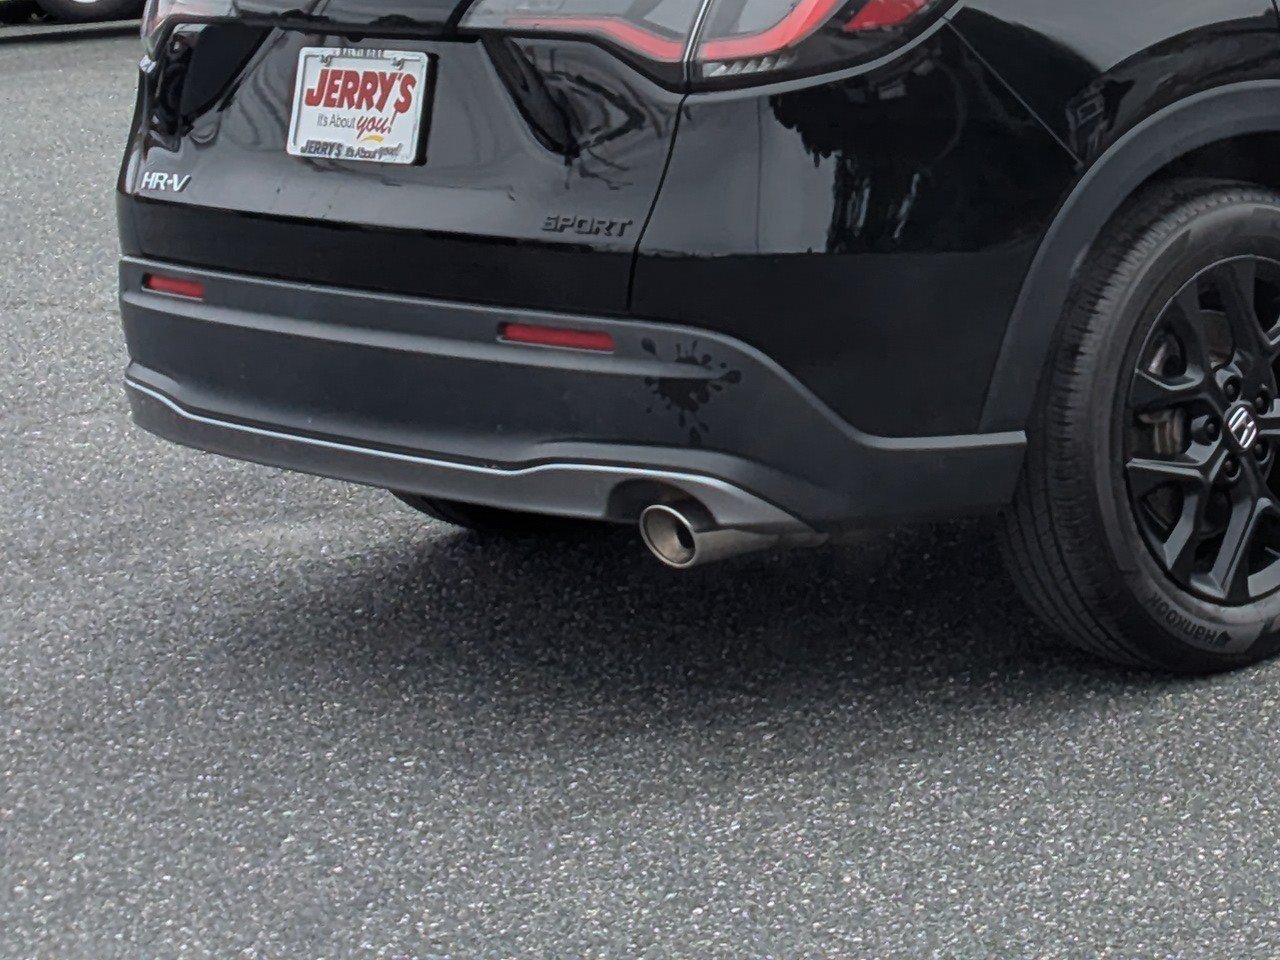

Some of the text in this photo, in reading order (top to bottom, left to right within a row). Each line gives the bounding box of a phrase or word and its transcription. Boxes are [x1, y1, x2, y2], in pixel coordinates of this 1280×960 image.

[305, 69, 417, 114] JERRY'S
[317, 110, 398, 140] It's About you!
[301, 139, 342, 157] JERRY'S
[140, 171, 192, 192] HR-V
[541, 215, 634, 237] SPORT
